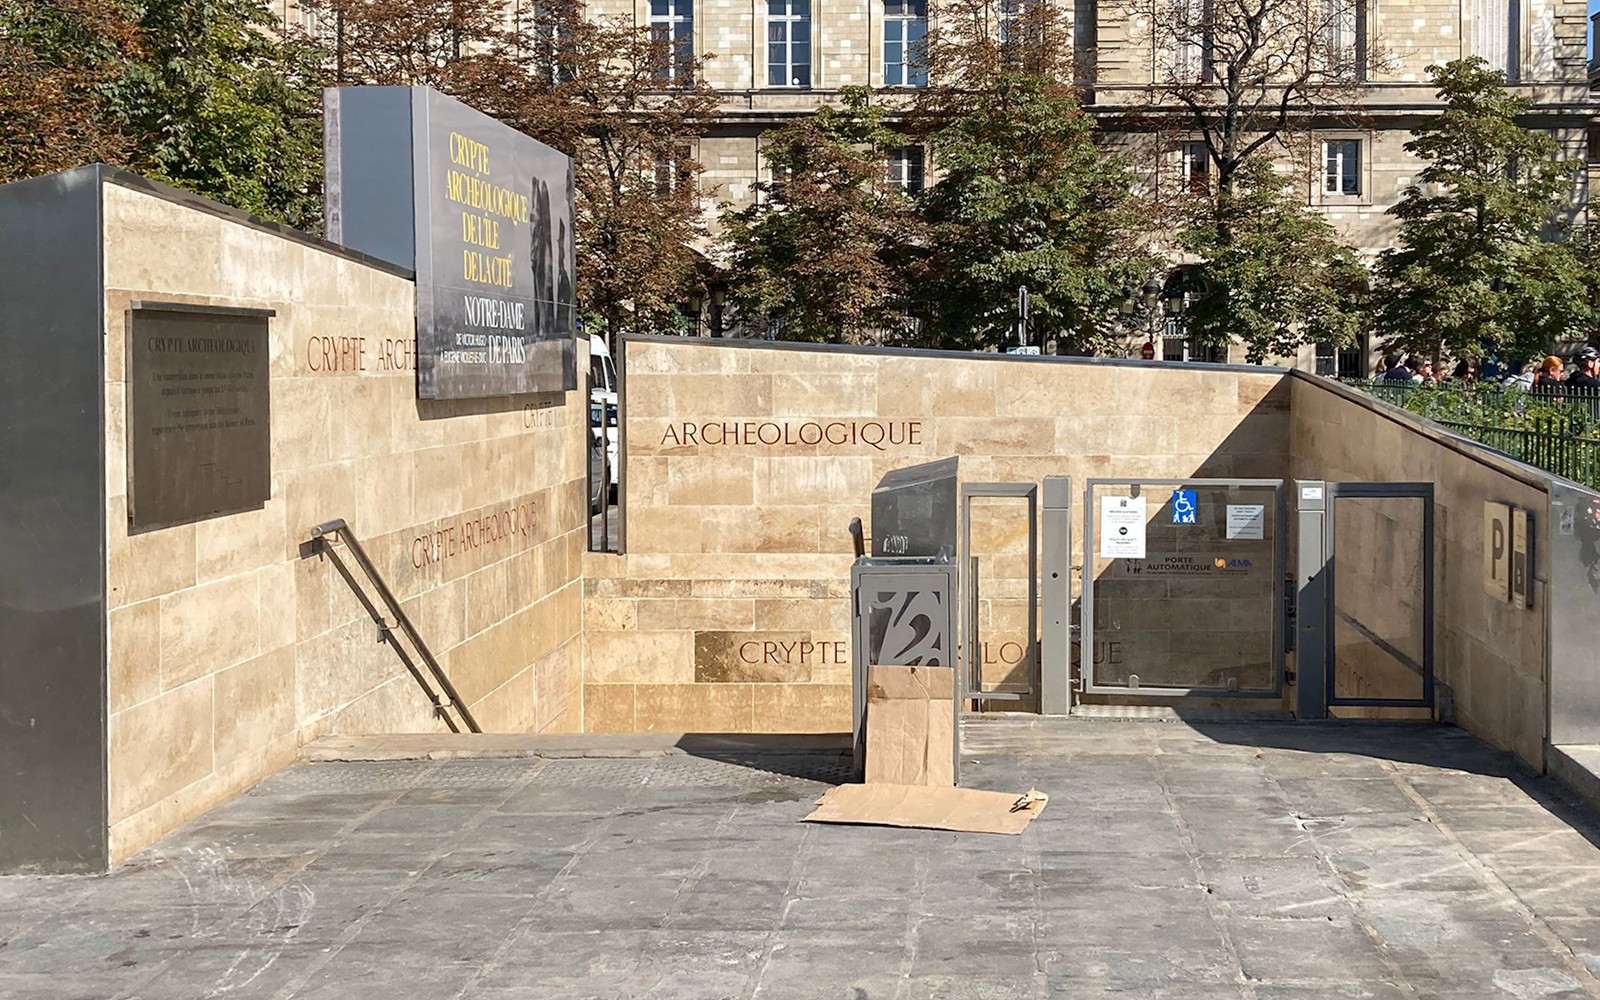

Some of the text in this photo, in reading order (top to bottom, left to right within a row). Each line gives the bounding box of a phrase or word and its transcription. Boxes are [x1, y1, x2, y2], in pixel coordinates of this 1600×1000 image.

[449, 131, 490, 175] CRYPTE
[445, 169, 528, 226] ARCHÉOLOGIQUE
[463, 212, 478, 244] DE
[463, 249, 513, 288] DE LA CITÉ
[464, 295, 525, 330] NOTRE-DAME
[148, 336, 182, 353] CRYPTE
[307, 335, 366, 372] CRYPTE
[488, 334, 526, 365] DE PARIS
[524, 401, 553, 429] CRYPTE
[660, 421, 922, 451] ARCHEOLOGIQUE
[411, 501, 538, 569] CRYPTE ARCHEOLOGIQUE
[1491, 518, 1505, 580] P
[1147, 563, 1212, 572] AUTOMATIQUE
[1165, 556, 1194, 564] PORTE
[739, 640, 847, 665] CRYPTE
